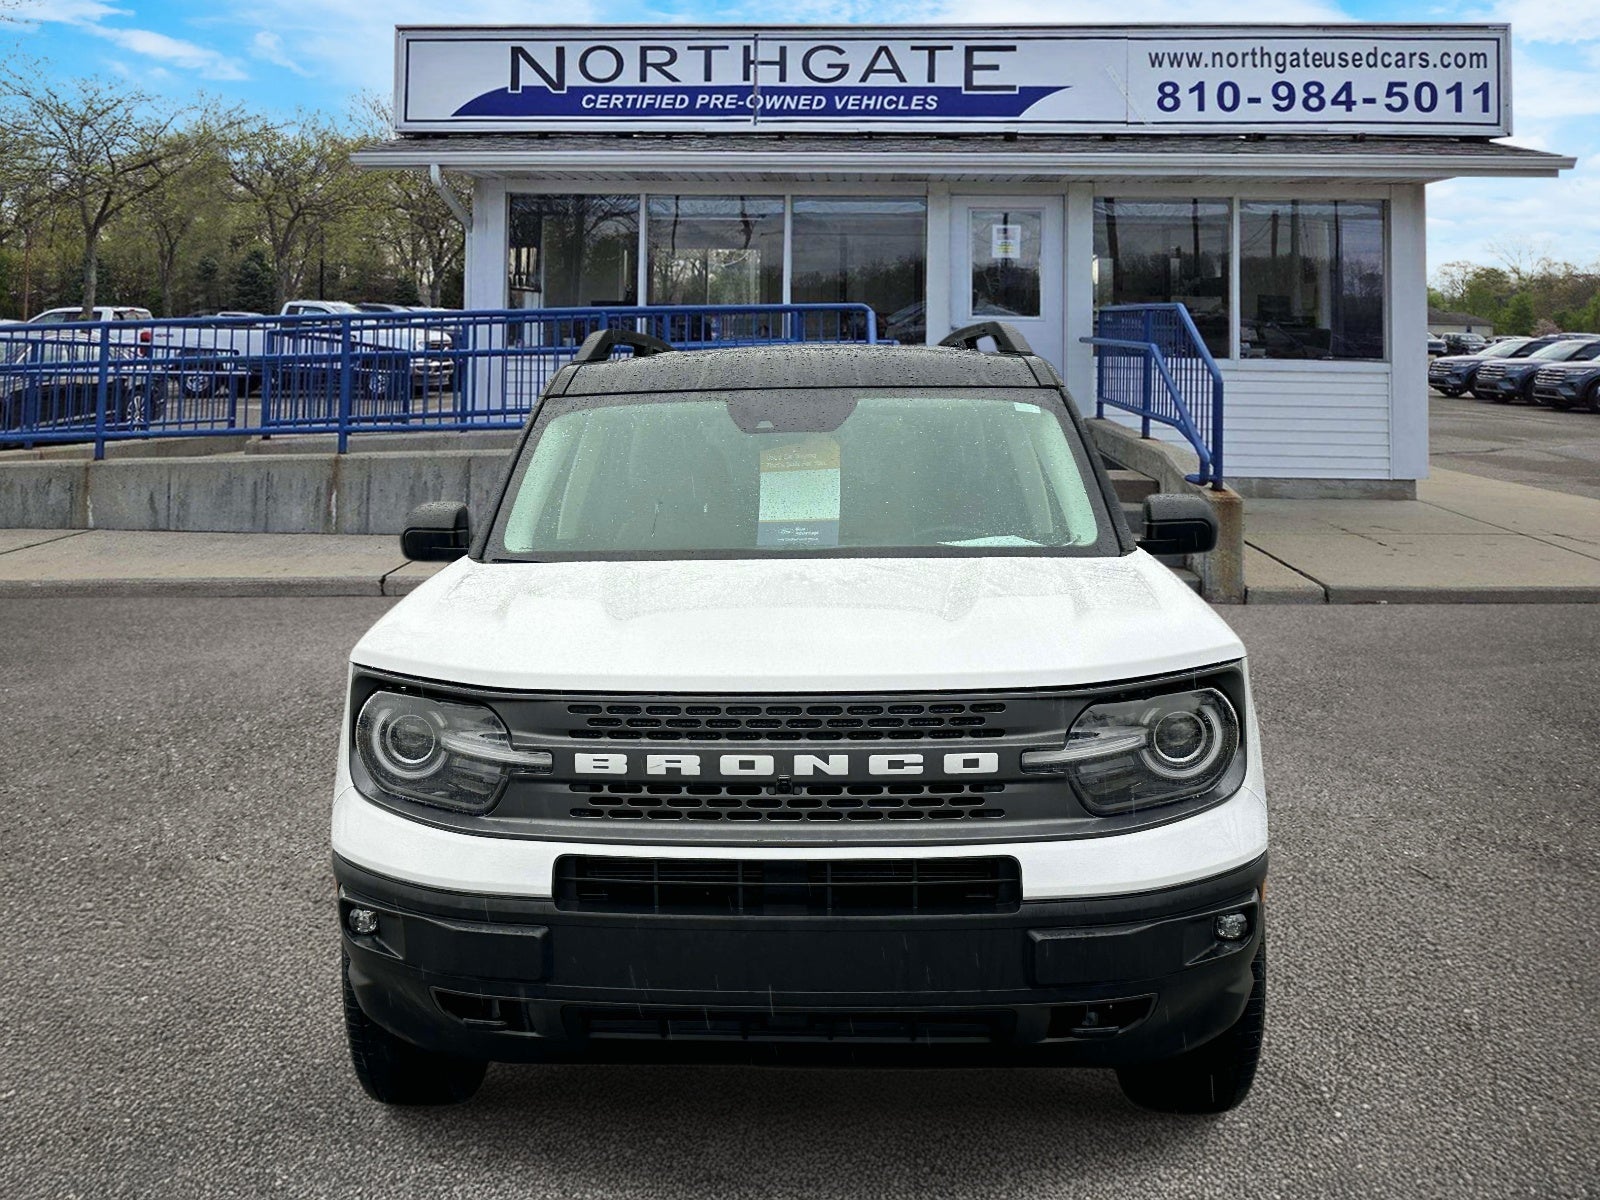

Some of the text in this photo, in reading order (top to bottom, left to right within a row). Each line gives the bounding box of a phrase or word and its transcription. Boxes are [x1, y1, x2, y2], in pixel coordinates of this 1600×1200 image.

[510, 45, 1017, 91] NORTHGATE
[1148, 46, 1488, 73] www.northgateusedcars.com
[581, 94, 939, 111] CERTIFIED PRE-OWNED VEHICLES
[1156, 80, 1491, 114] 810-984-5011
[574, 752, 999, 776] BRONCO
